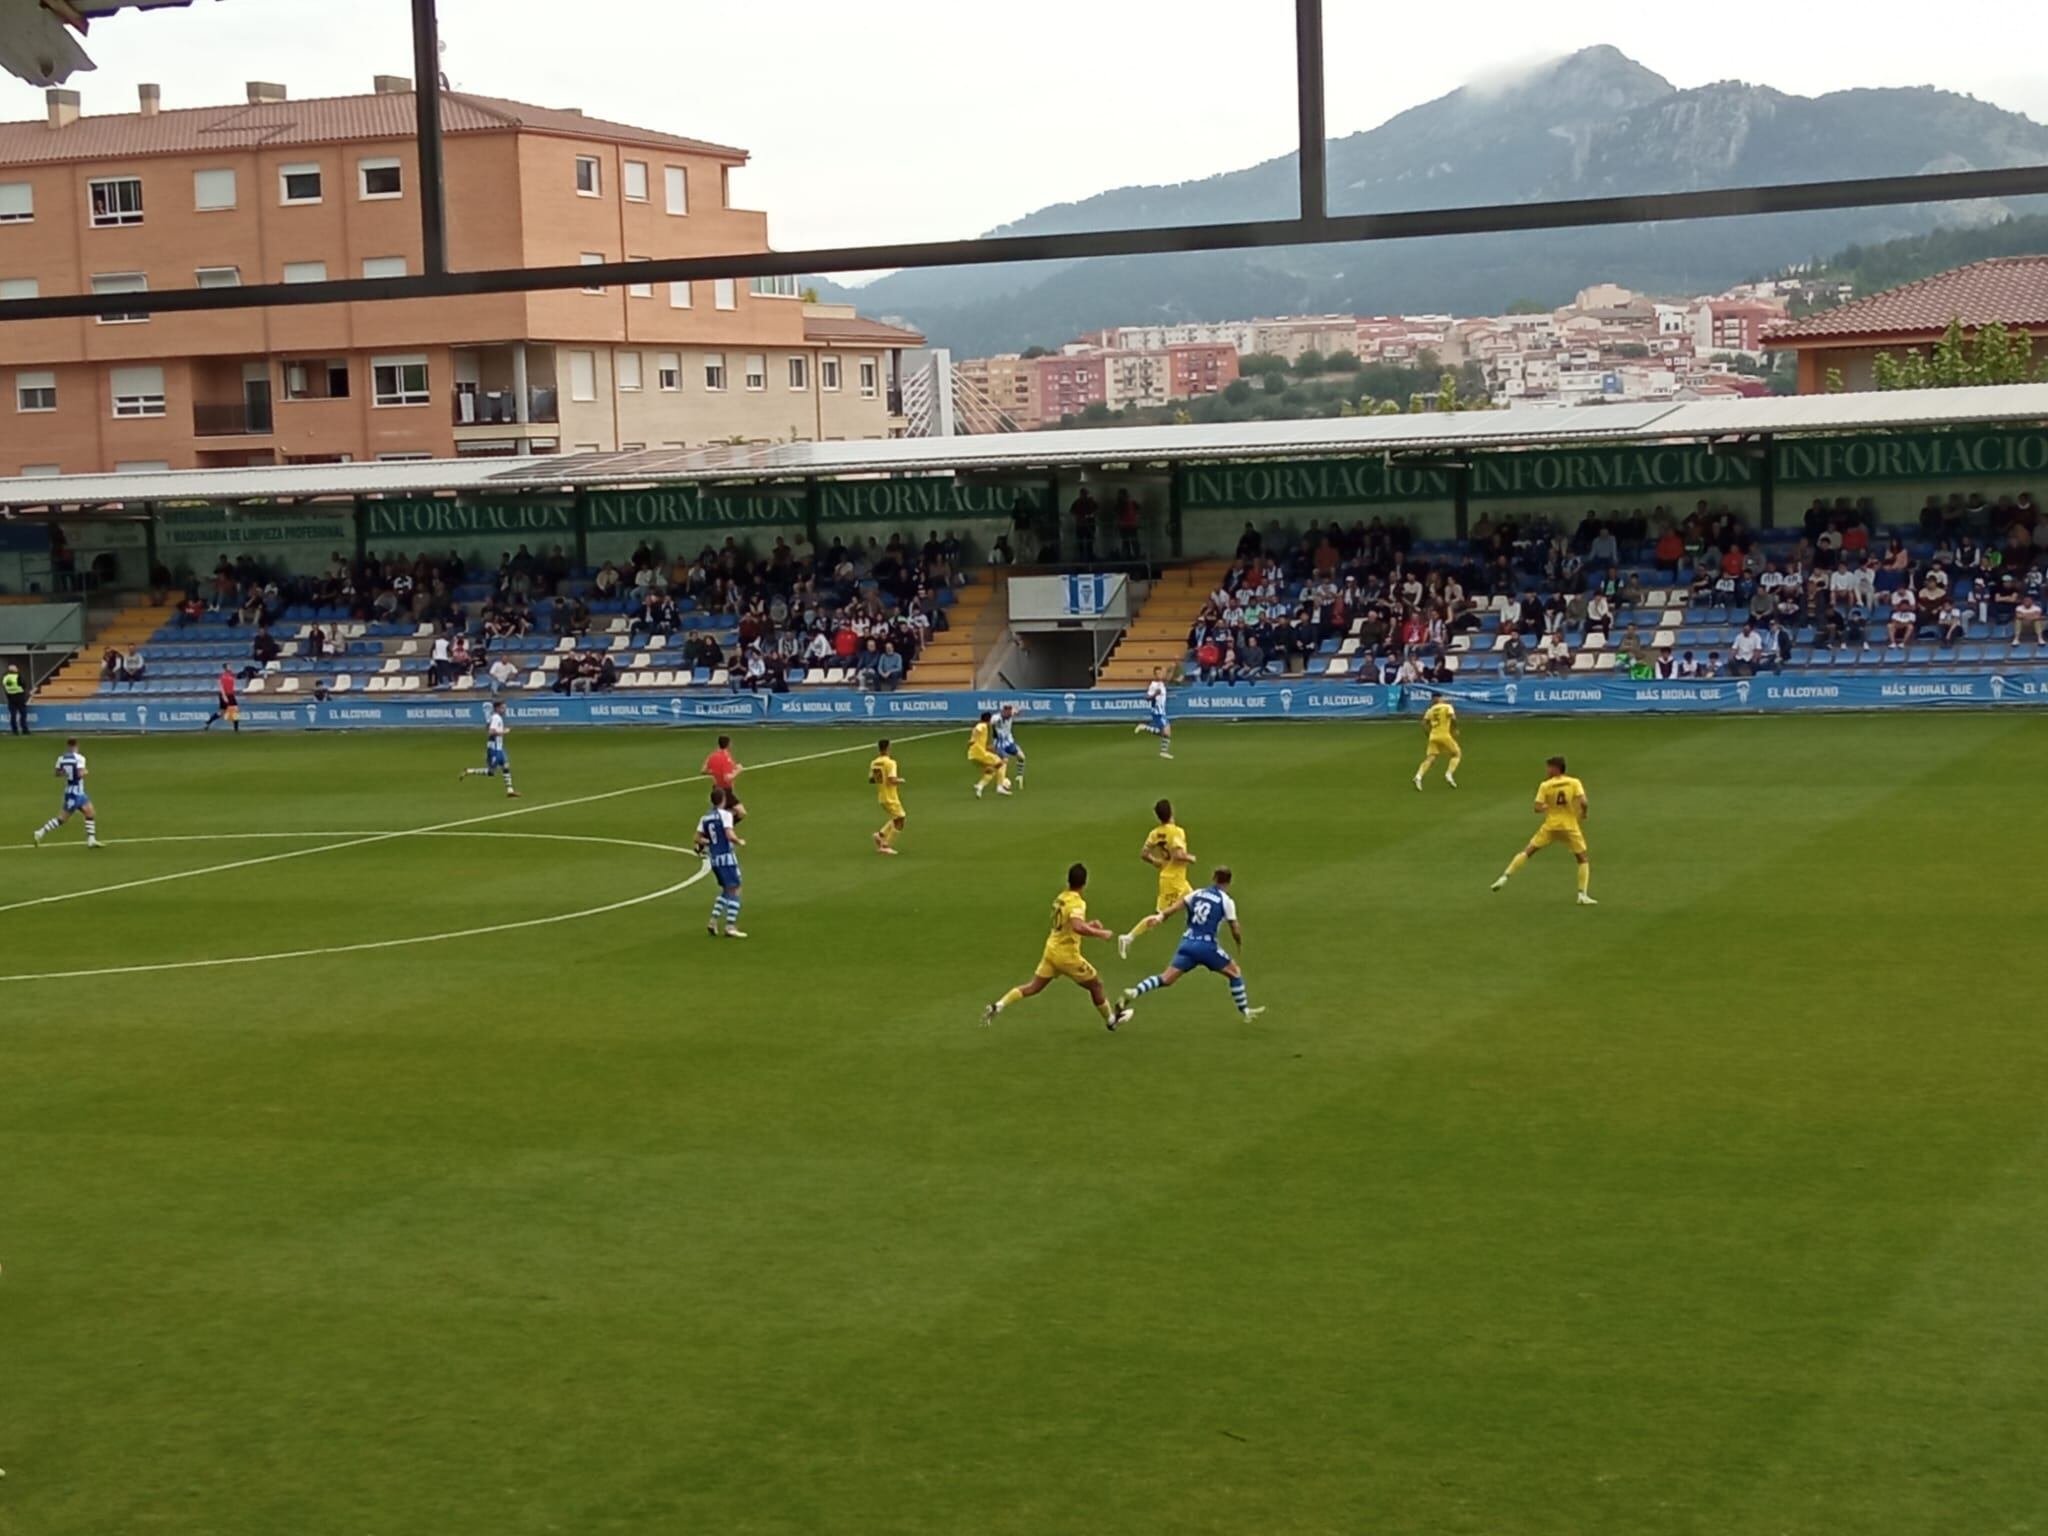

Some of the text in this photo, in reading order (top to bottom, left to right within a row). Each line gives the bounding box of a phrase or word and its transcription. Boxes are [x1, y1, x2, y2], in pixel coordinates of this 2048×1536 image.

[1636, 688, 1721, 700] MÁS MORAL QUE
[1767, 687, 1838, 698] EL ALCOYANO
[1881, 683, 1973, 696] MÁS MORAL QUE
[2023, 683, 2037, 694] EL
[1309, 695, 1373, 706] EL ALCOYANO
[1535, 690, 1602, 701] EL ALCOYANO
[782, 702, 852, 712] MÁS MORAL QUE
[890, 701, 948, 711] EL ALCOYANO
[978, 699, 997, 710] MÁS
[1033, 700, 1050, 710] QUE
[1091, 700, 1102, 710] EL
[1188, 696, 1266, 707] MÁS MORAL QUE
[611, 706, 640, 715] MORAL
[1556, 790, 1567, 806] 4
